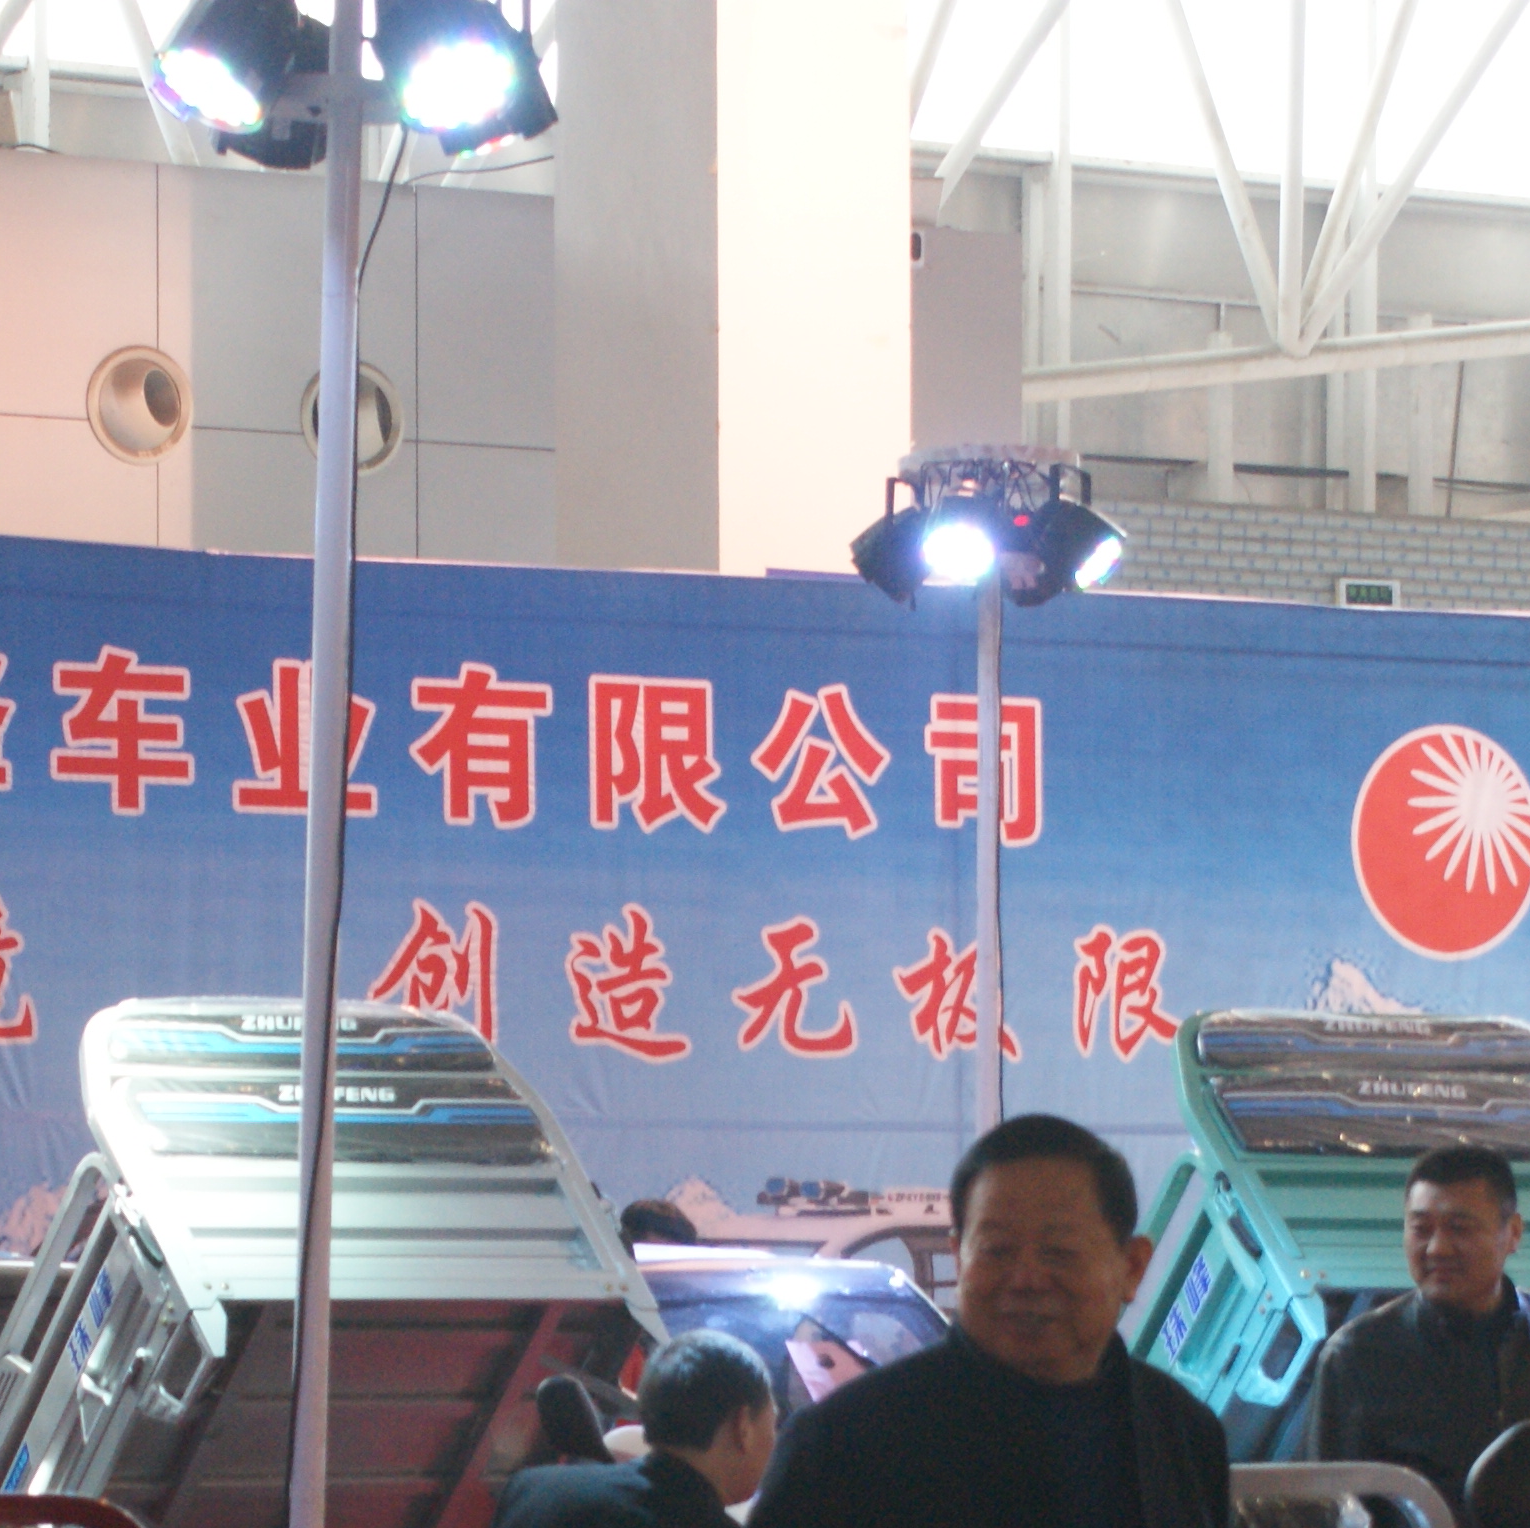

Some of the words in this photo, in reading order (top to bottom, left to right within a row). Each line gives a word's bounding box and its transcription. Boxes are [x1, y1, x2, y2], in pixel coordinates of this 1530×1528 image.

[371, 903, 1179, 1057] 创造无极限
[241, 1015, 357, 1031] ZHUG
[279, 1085, 395, 1102] ZFENG
